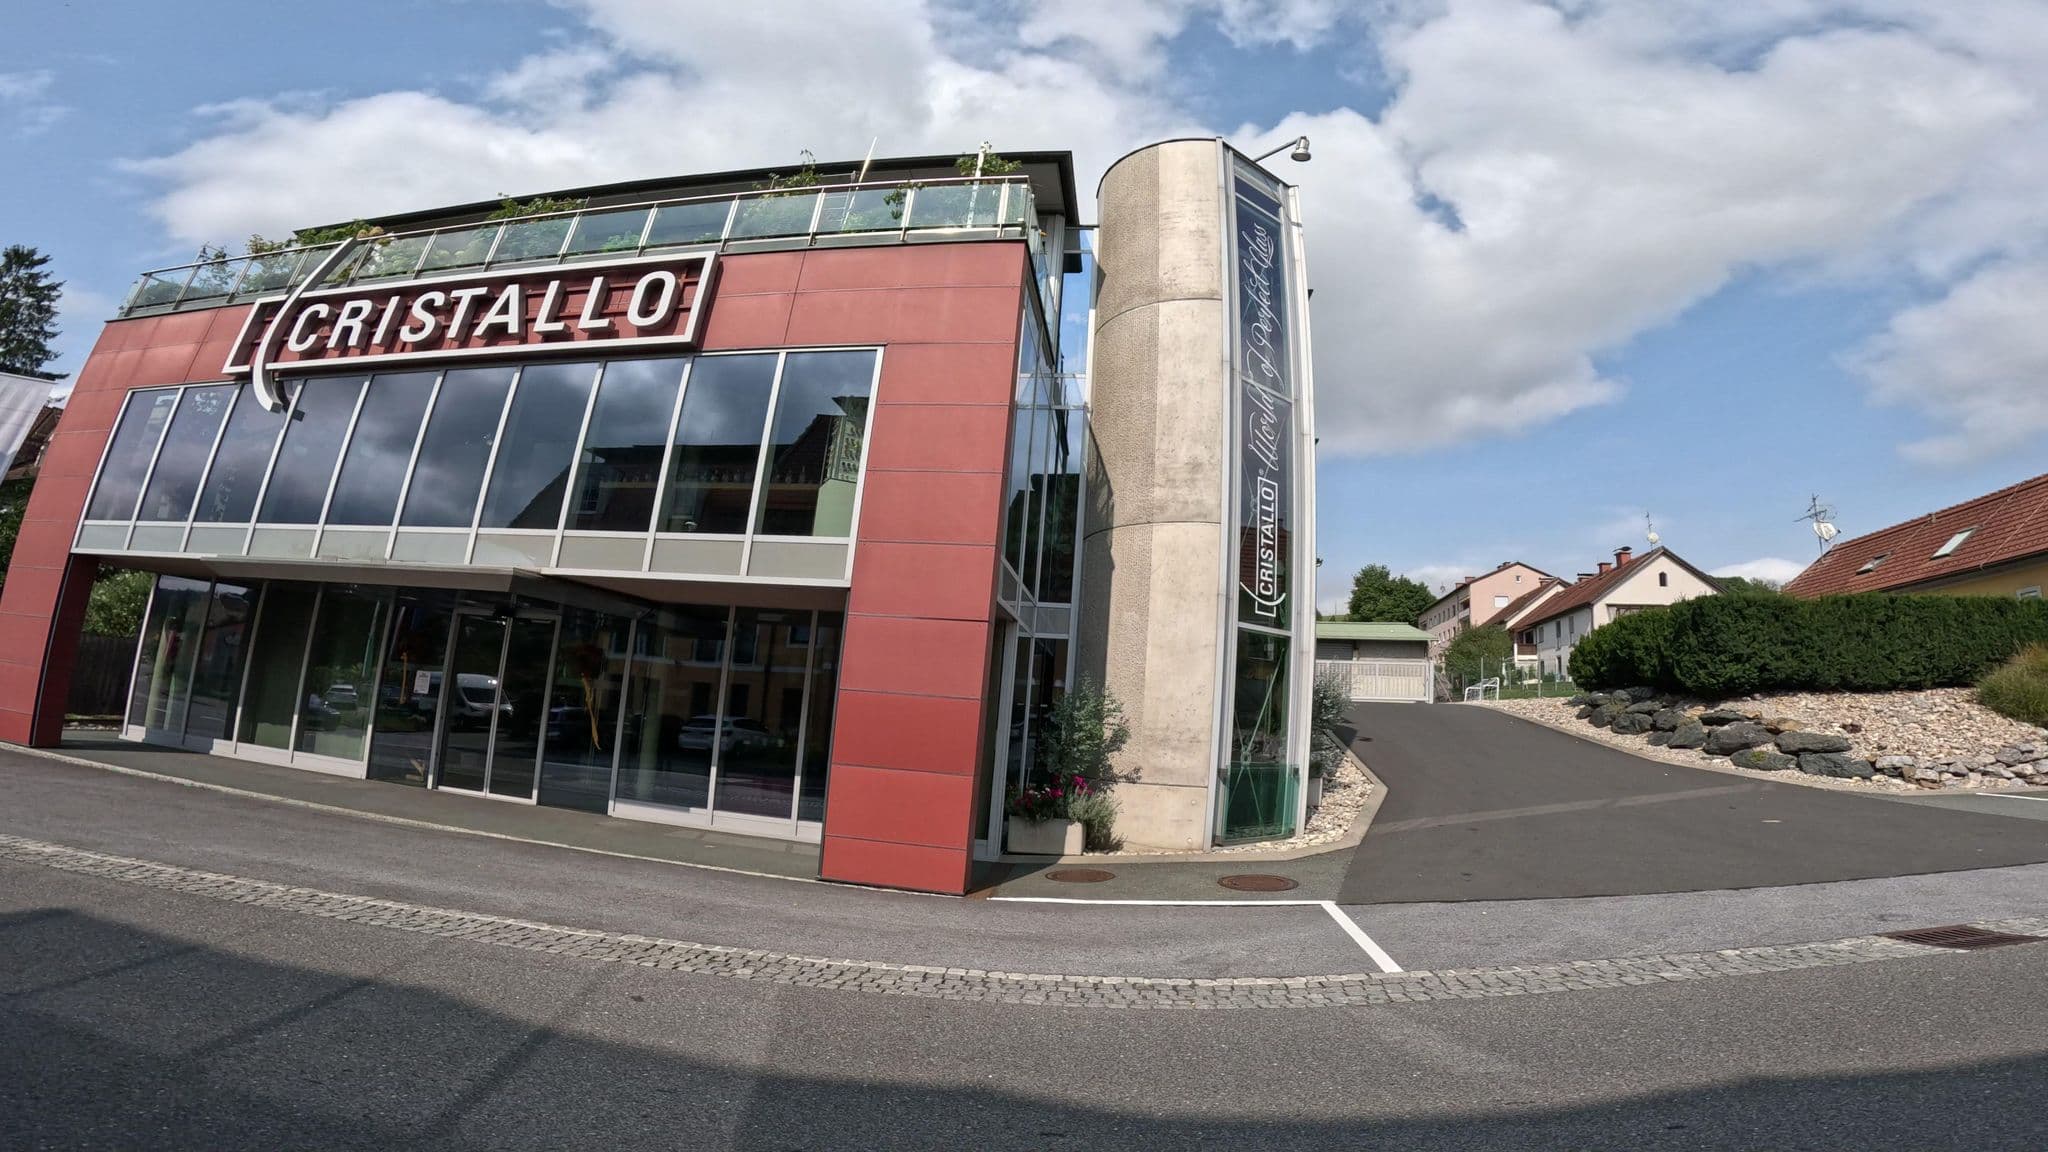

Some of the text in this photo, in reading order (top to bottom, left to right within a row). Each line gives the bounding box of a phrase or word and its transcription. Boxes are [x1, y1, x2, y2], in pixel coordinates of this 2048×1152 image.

[286, 269, 680, 353] CRISTALLO
[1243, 259, 1283, 354] Perfect
[1246, 339, 1285, 393] of
[1247, 376, 1279, 471] World
[1259, 486, 1275, 596] CRISTALLO
